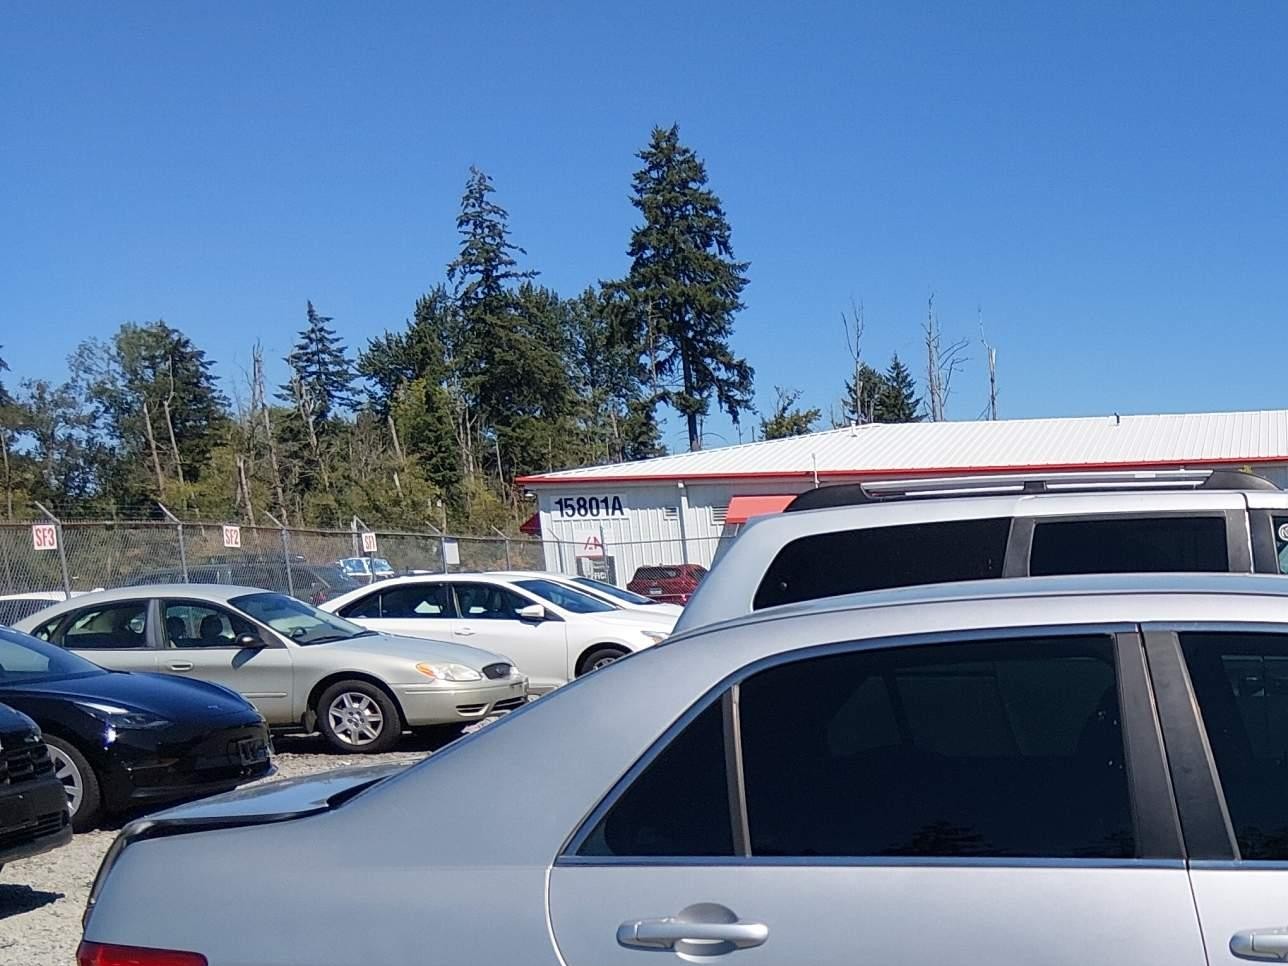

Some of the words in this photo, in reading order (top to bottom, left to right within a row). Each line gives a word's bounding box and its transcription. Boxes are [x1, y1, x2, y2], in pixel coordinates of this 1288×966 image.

[555, 496, 624, 517] 15801A
[35, 528, 55, 546] SF3
[225, 529, 239, 545] SF2
[364, 535, 375, 549] SF1
